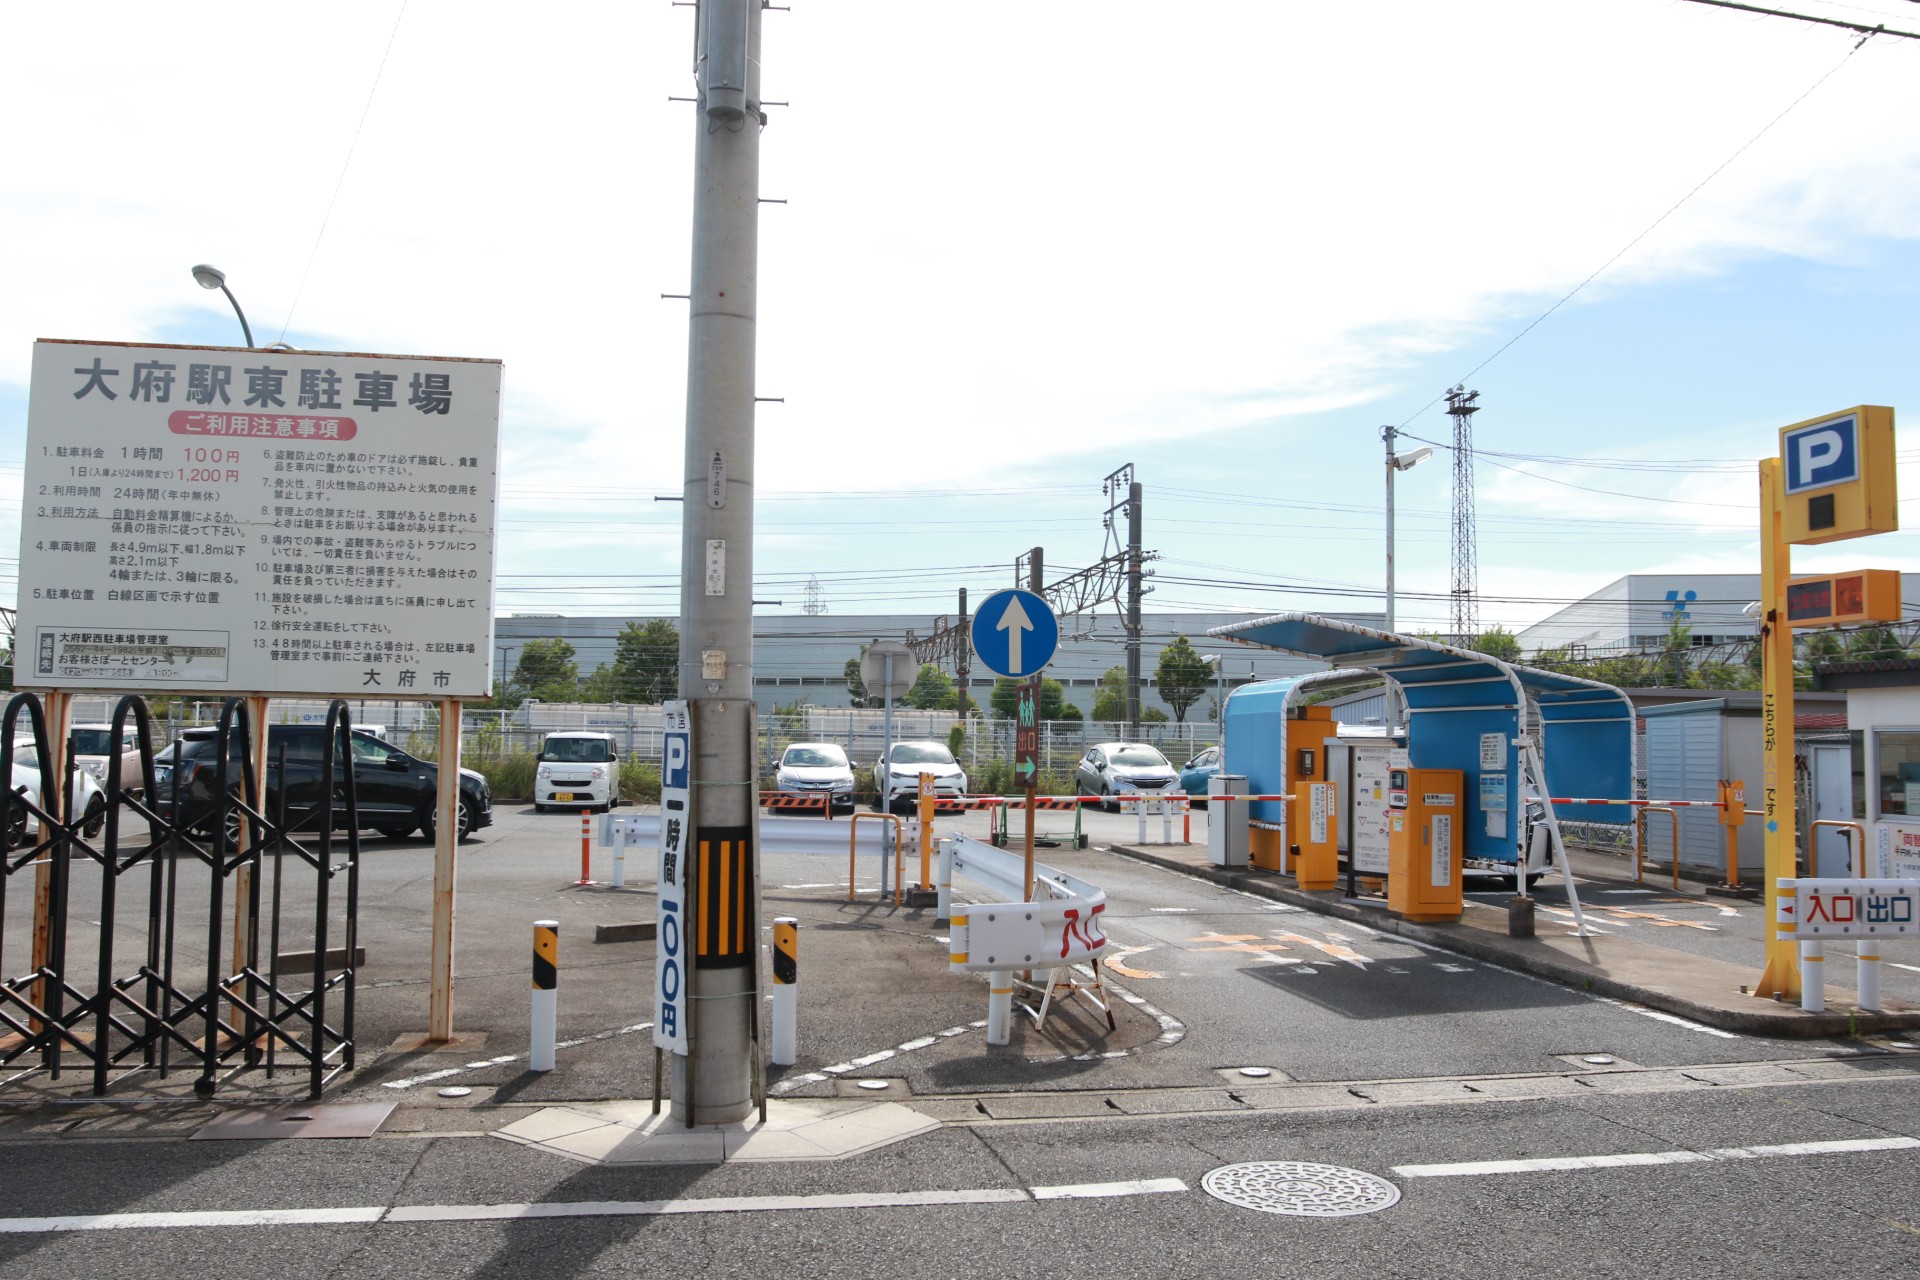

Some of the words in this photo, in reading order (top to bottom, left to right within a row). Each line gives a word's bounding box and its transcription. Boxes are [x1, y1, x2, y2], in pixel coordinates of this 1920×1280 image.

[73, 358, 453, 415] 大府駅東駐車場
[184, 413, 340, 439] ご利用注意事項
[1799, 430, 1843, 484] P
[108, 589, 220, 604] 白線区画で示す位置
[1018, 731, 1035, 751] 出口
[666, 737, 686, 785] P
[1806, 896, 1853, 923] 入口
[1867, 896, 1911, 922] 出口
[1061, 903, 1106, 959] 入口
